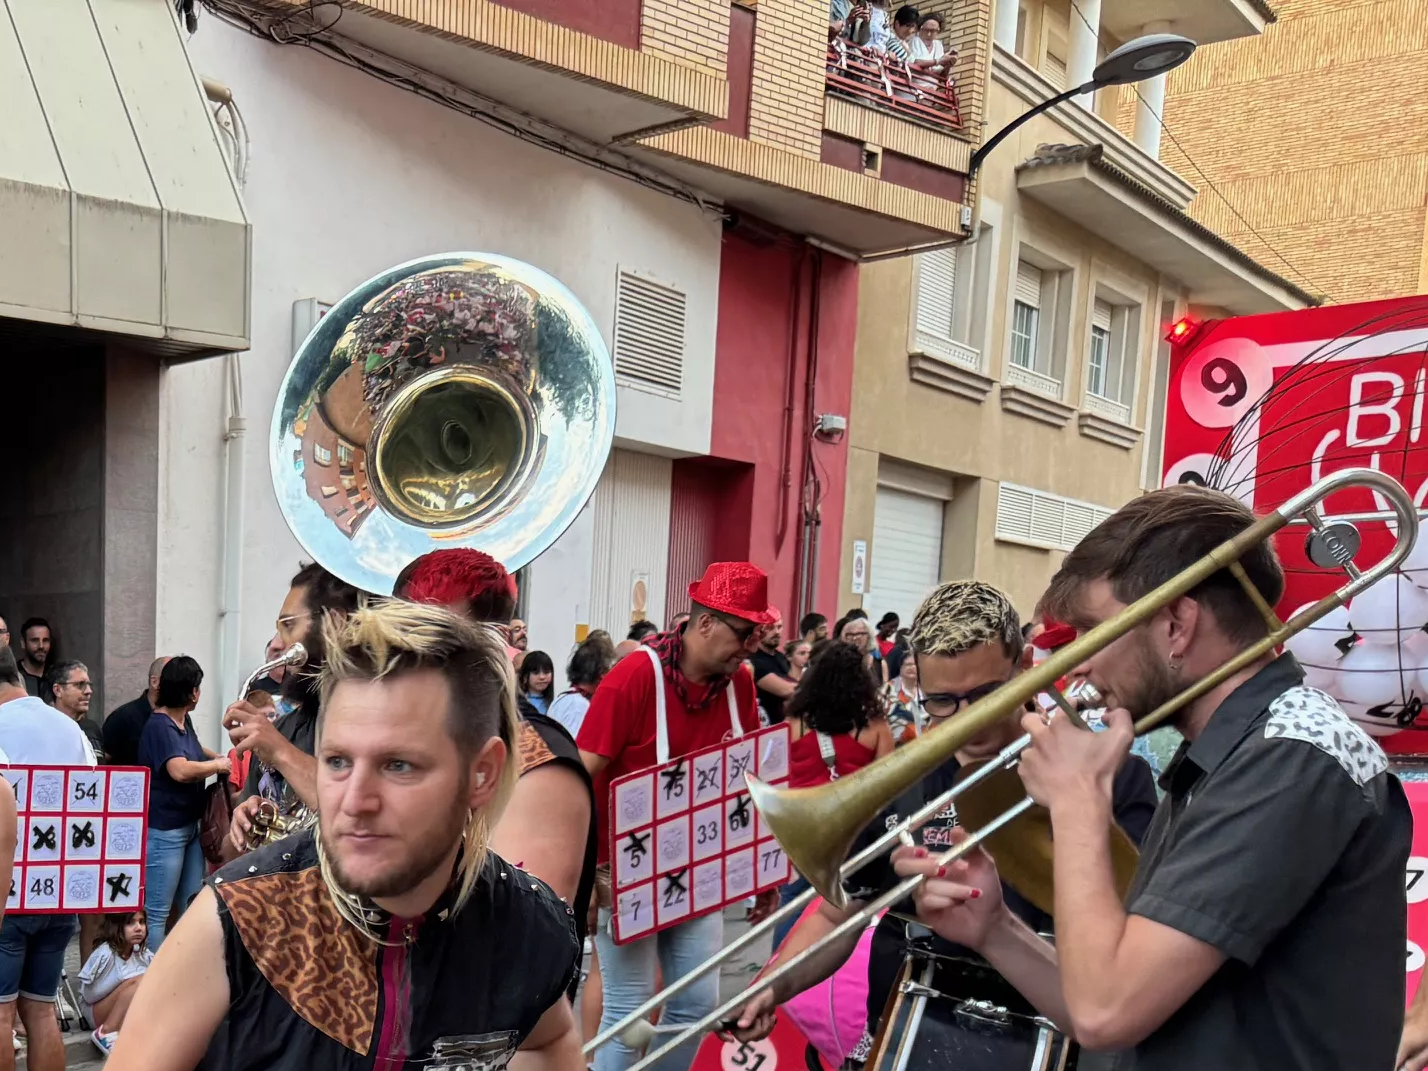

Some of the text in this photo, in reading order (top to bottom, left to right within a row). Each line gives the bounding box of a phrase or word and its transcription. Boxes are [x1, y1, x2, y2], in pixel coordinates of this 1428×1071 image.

[1199, 357, 1249, 408] 9
[74, 782, 98, 801] 54
[697, 821, 719, 845] 33
[762, 848, 783, 872] 77
[30, 878, 55, 897] 48
[631, 900, 642, 921] 7
